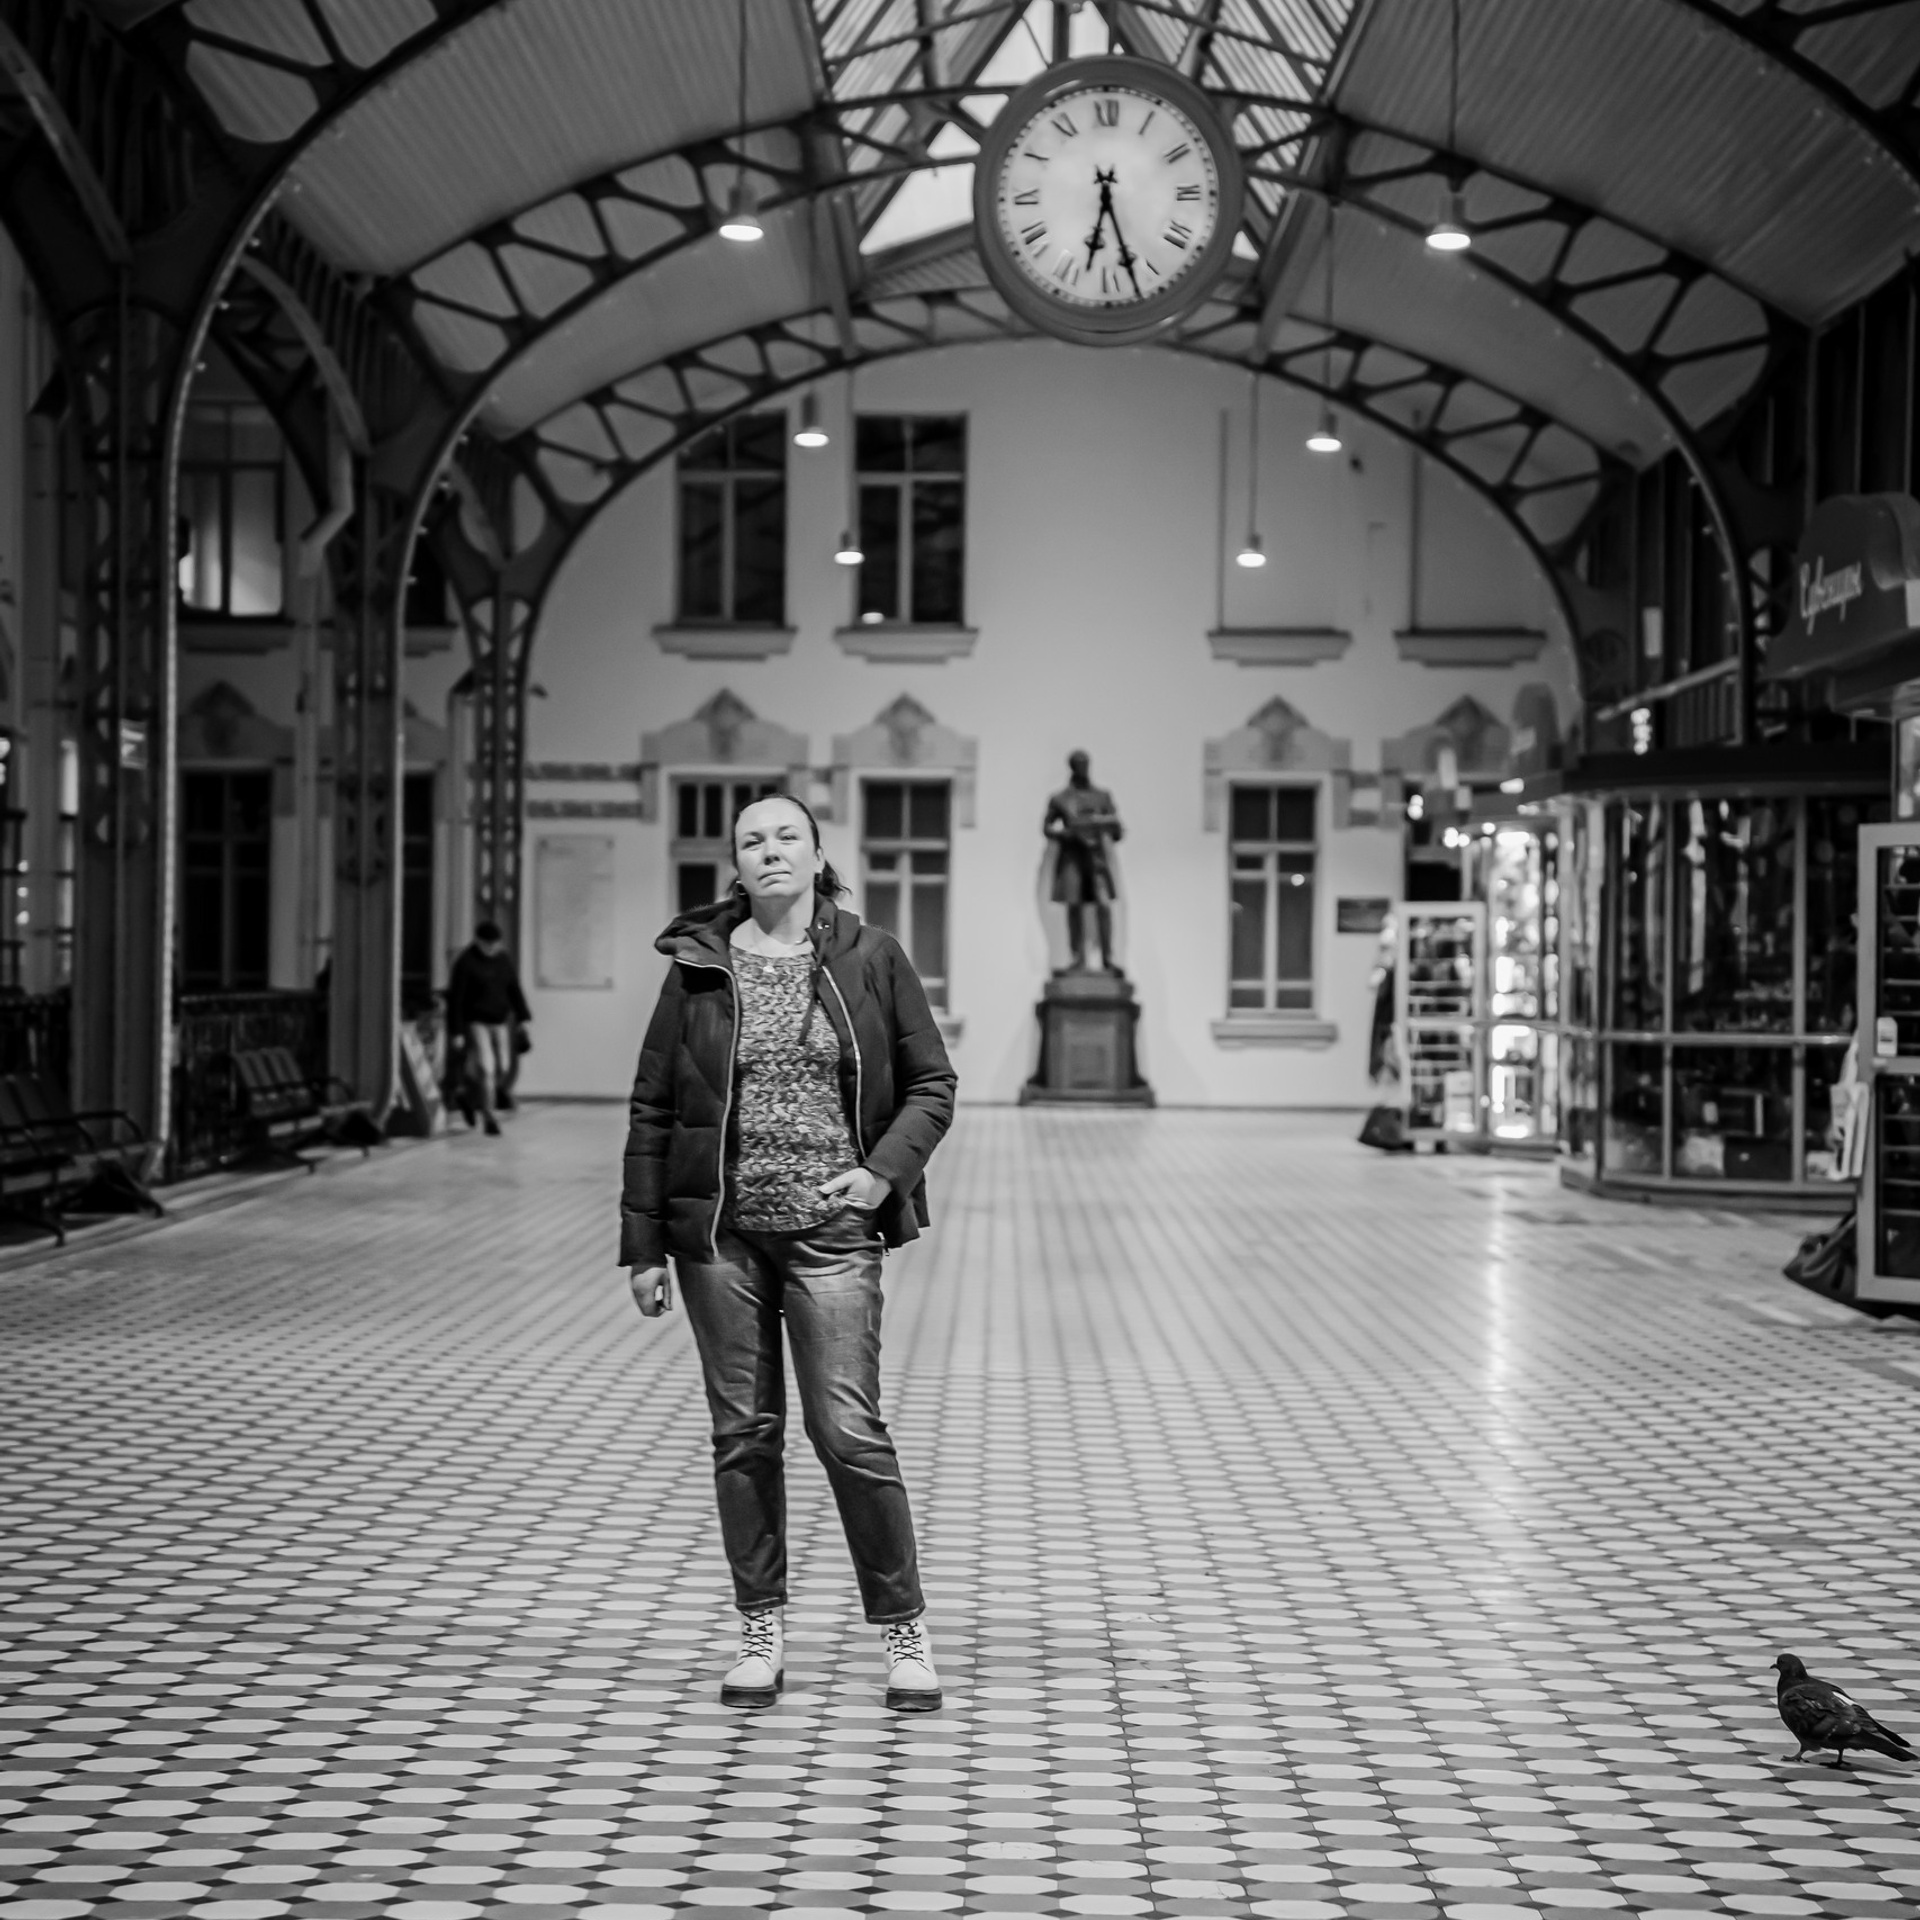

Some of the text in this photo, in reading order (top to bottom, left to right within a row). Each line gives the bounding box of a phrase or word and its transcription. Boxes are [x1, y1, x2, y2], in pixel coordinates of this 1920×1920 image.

[1138, 110, 1156, 135] I
[1163, 141, 1191, 164] II
[1176, 184, 1202, 202] III
